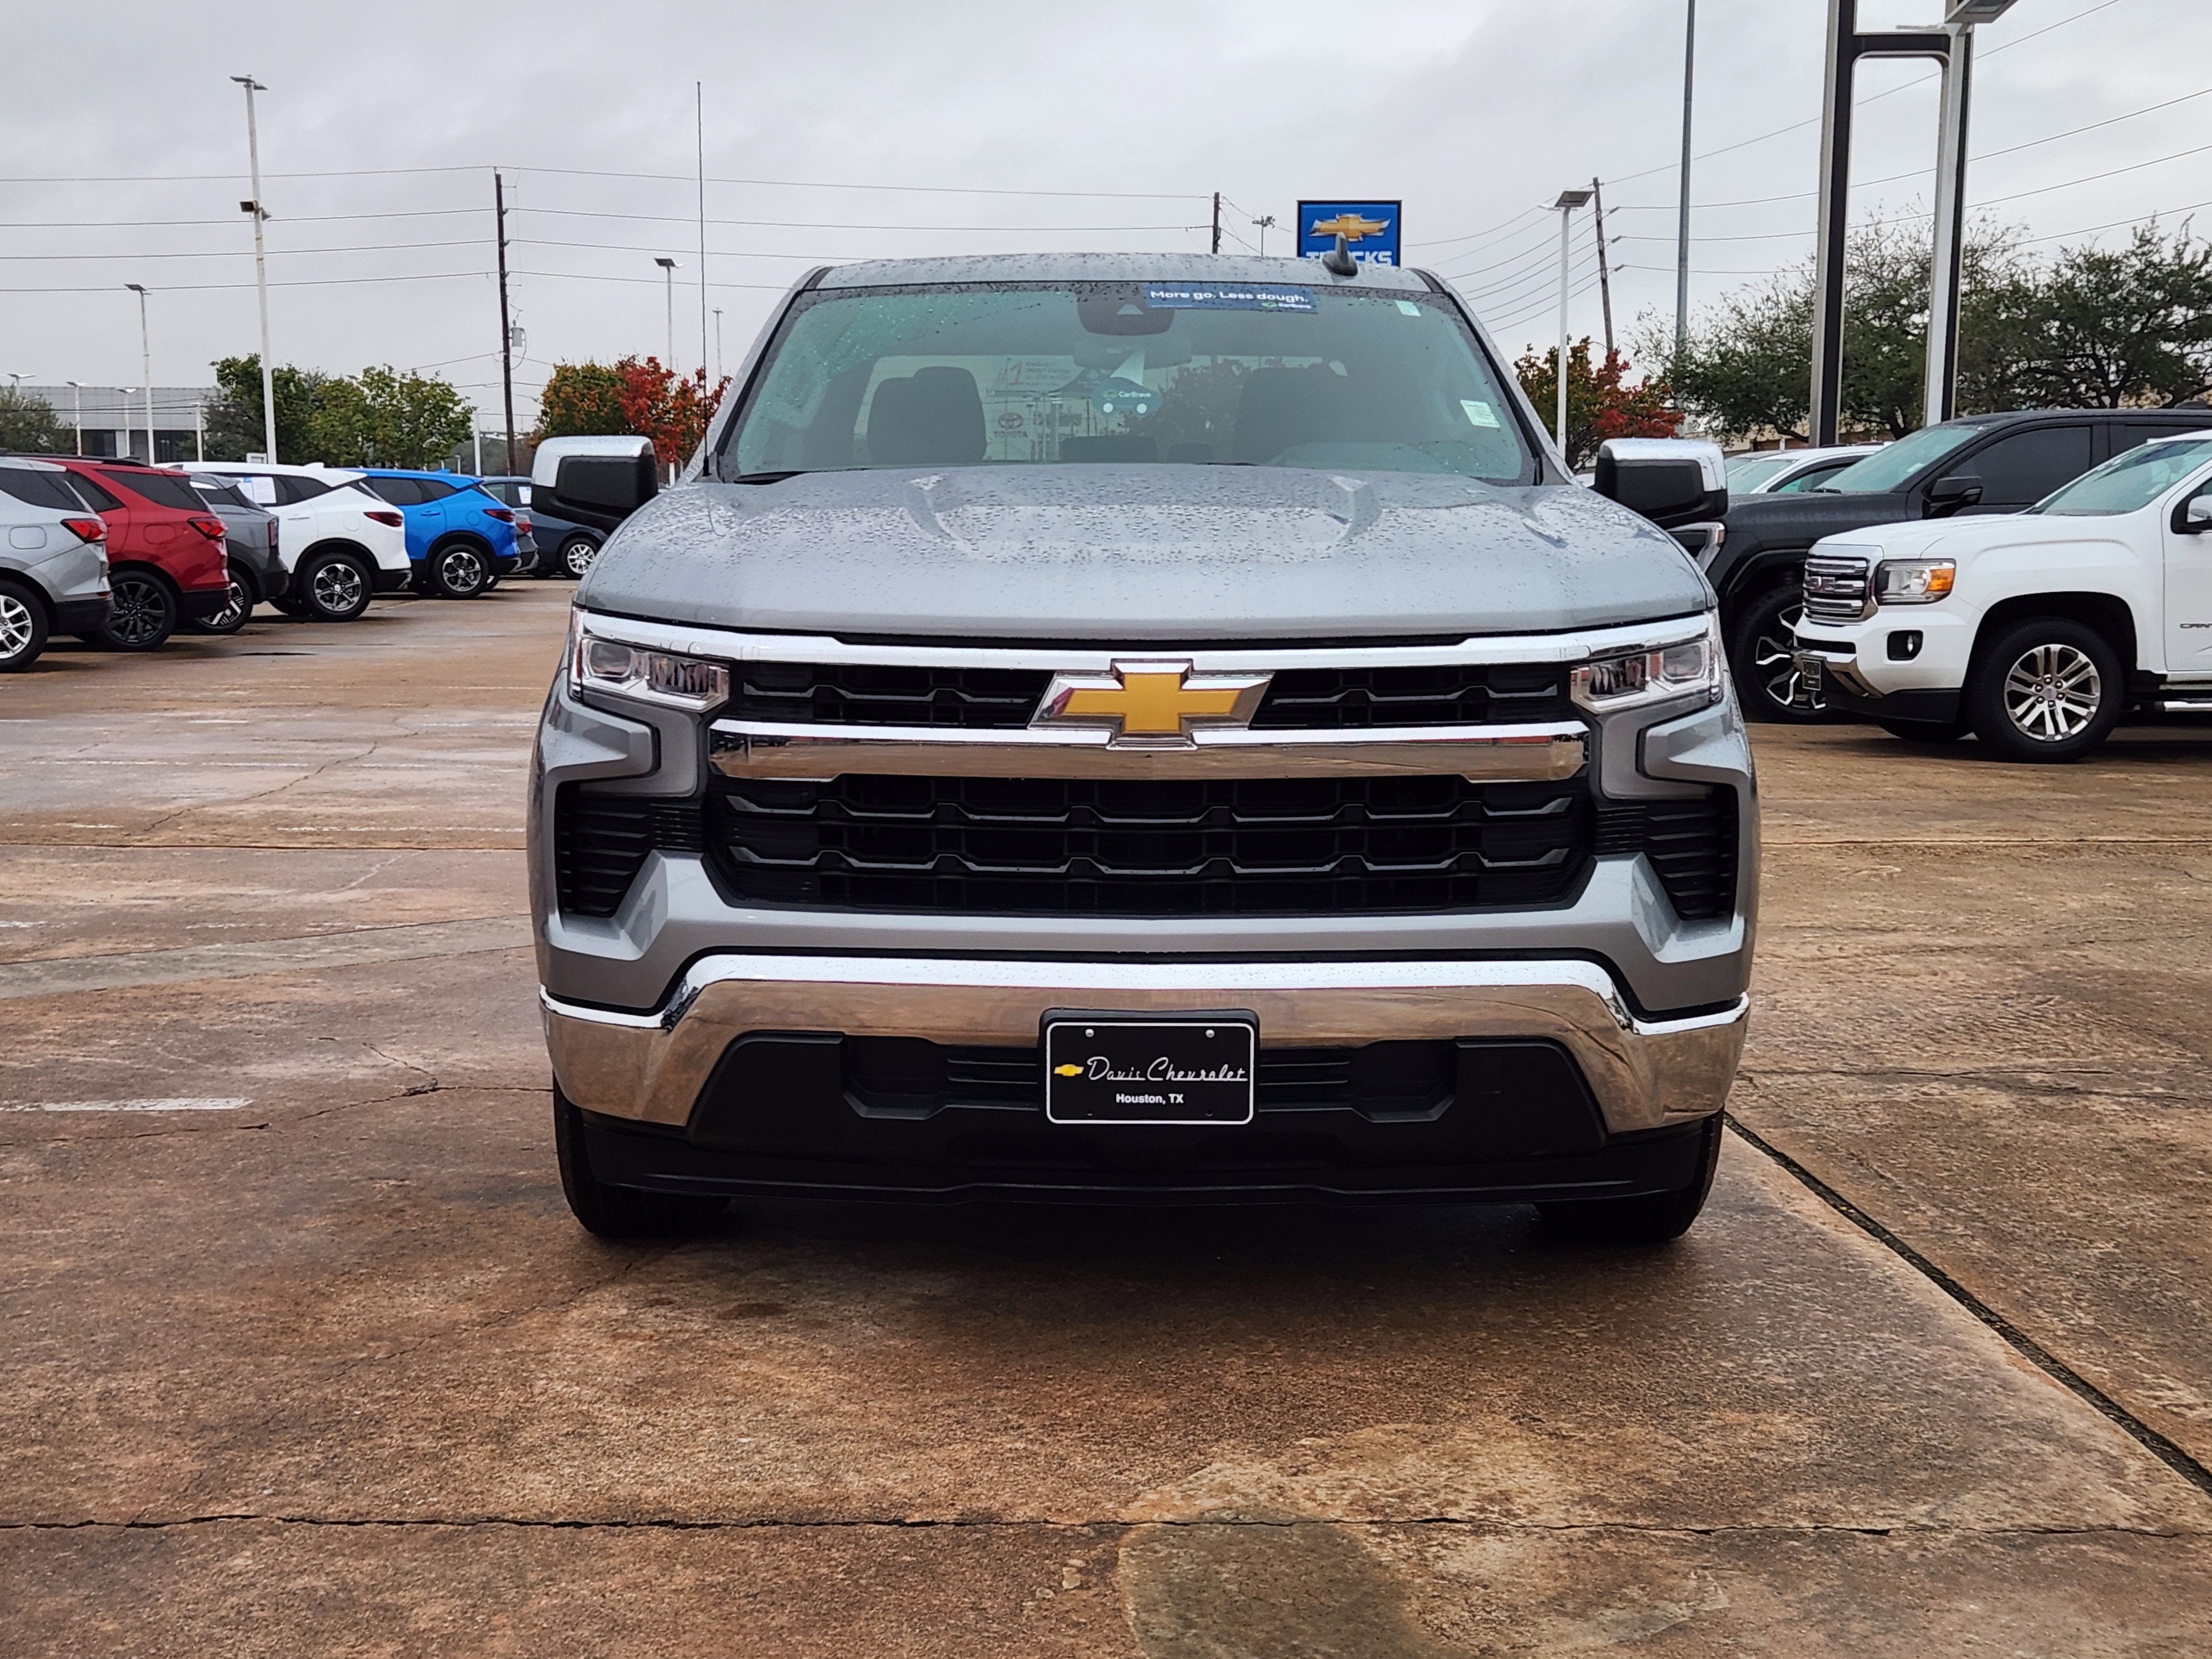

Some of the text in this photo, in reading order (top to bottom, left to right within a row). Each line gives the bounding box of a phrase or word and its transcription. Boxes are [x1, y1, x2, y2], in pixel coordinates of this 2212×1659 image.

[1306, 251, 1392, 266] TCKS
[1150, 290, 1191, 299] More
[1193, 292, 1217, 300] go.
[1256, 293, 1310, 303] dough.
[1087, 1056, 1248, 1082] Davis Chevrolet
[1115, 1093, 1184, 1105] Houston, TX
